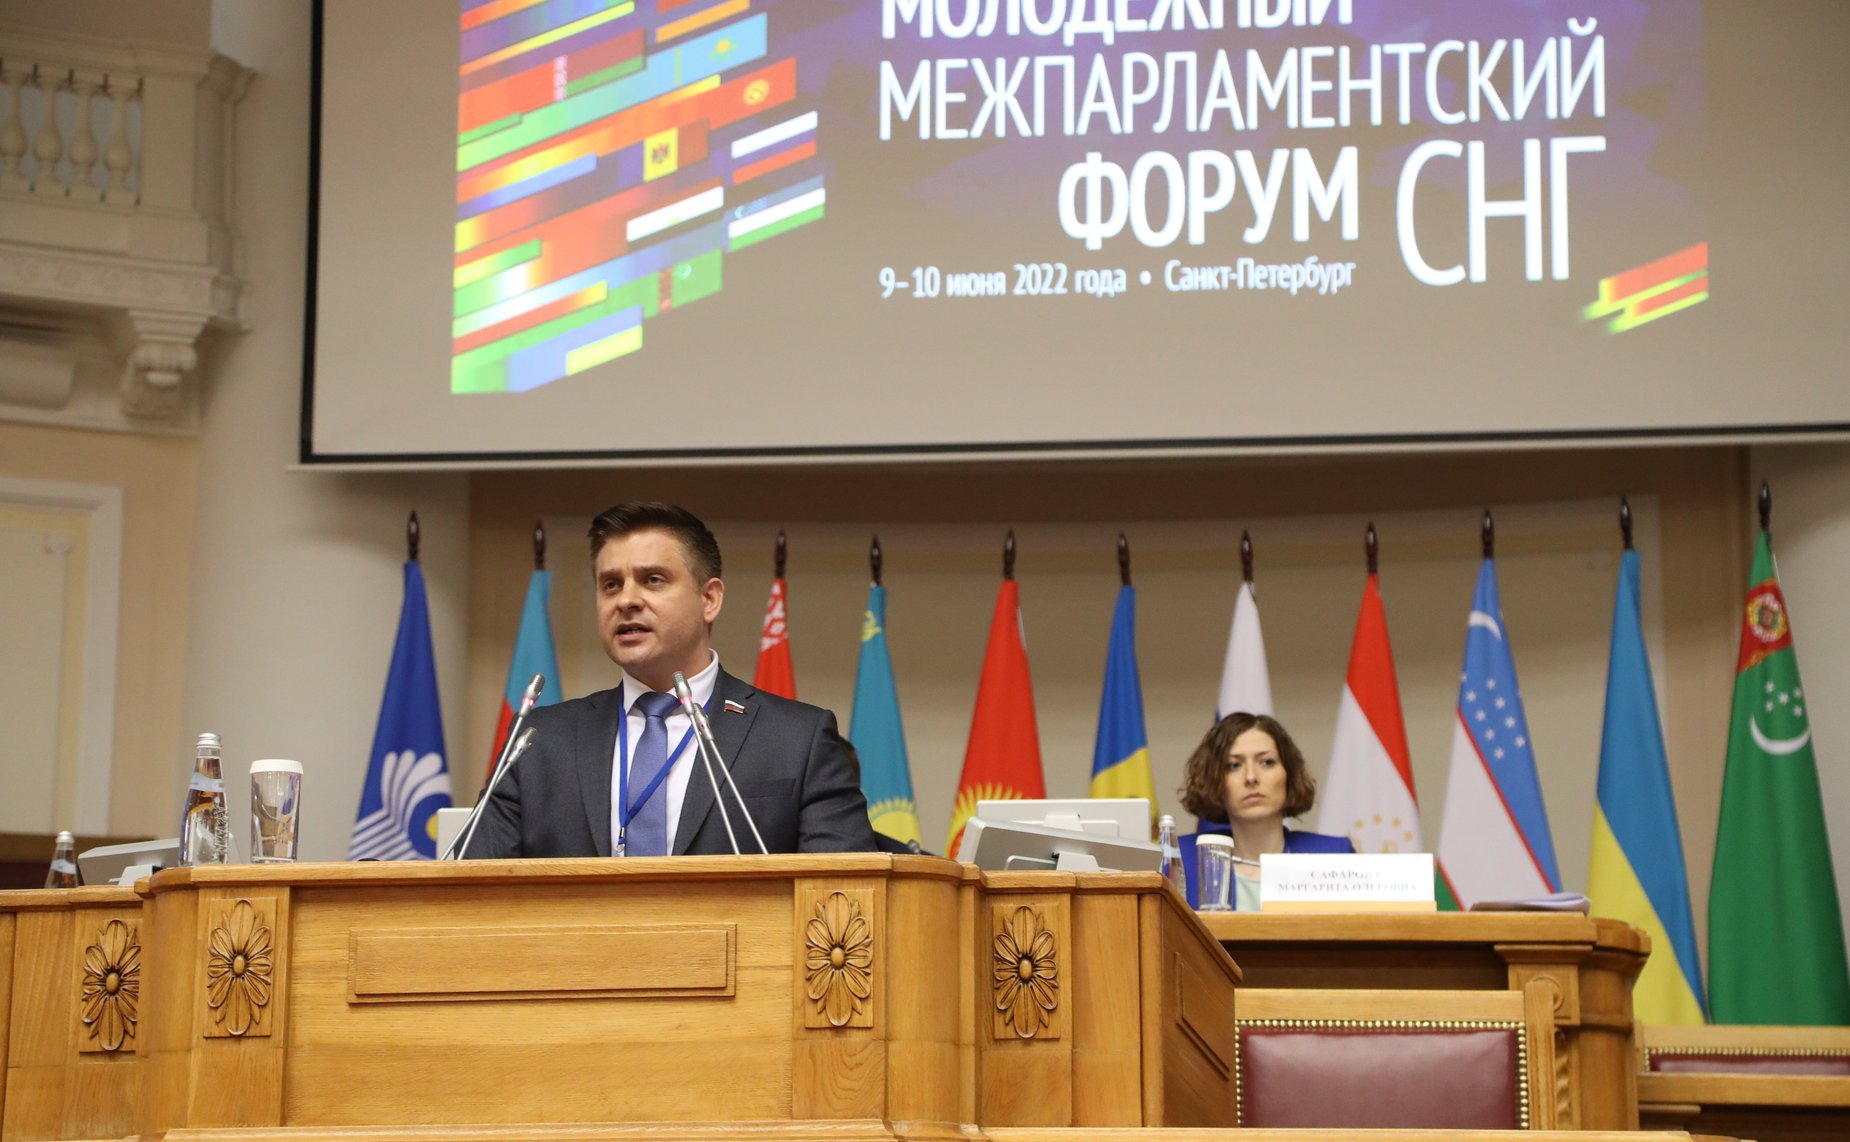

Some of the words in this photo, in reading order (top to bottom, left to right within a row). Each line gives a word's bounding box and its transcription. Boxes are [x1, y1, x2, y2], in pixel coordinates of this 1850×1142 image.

[881, 0, 1353, 46] МОЛОД
[880, 18, 1606, 140] МЕЖПАРЛАМЕНТСКИЙ
[1059, 146, 1360, 250] ФОРУМ
[1397, 136, 1607, 286] СНГ
[946, 271, 1006, 297] июня
[1013, 263, 1068, 296] 2022
[1075, 269, 1127, 298] года
[1165, 256, 1356, 295] Санкт-Петербург
